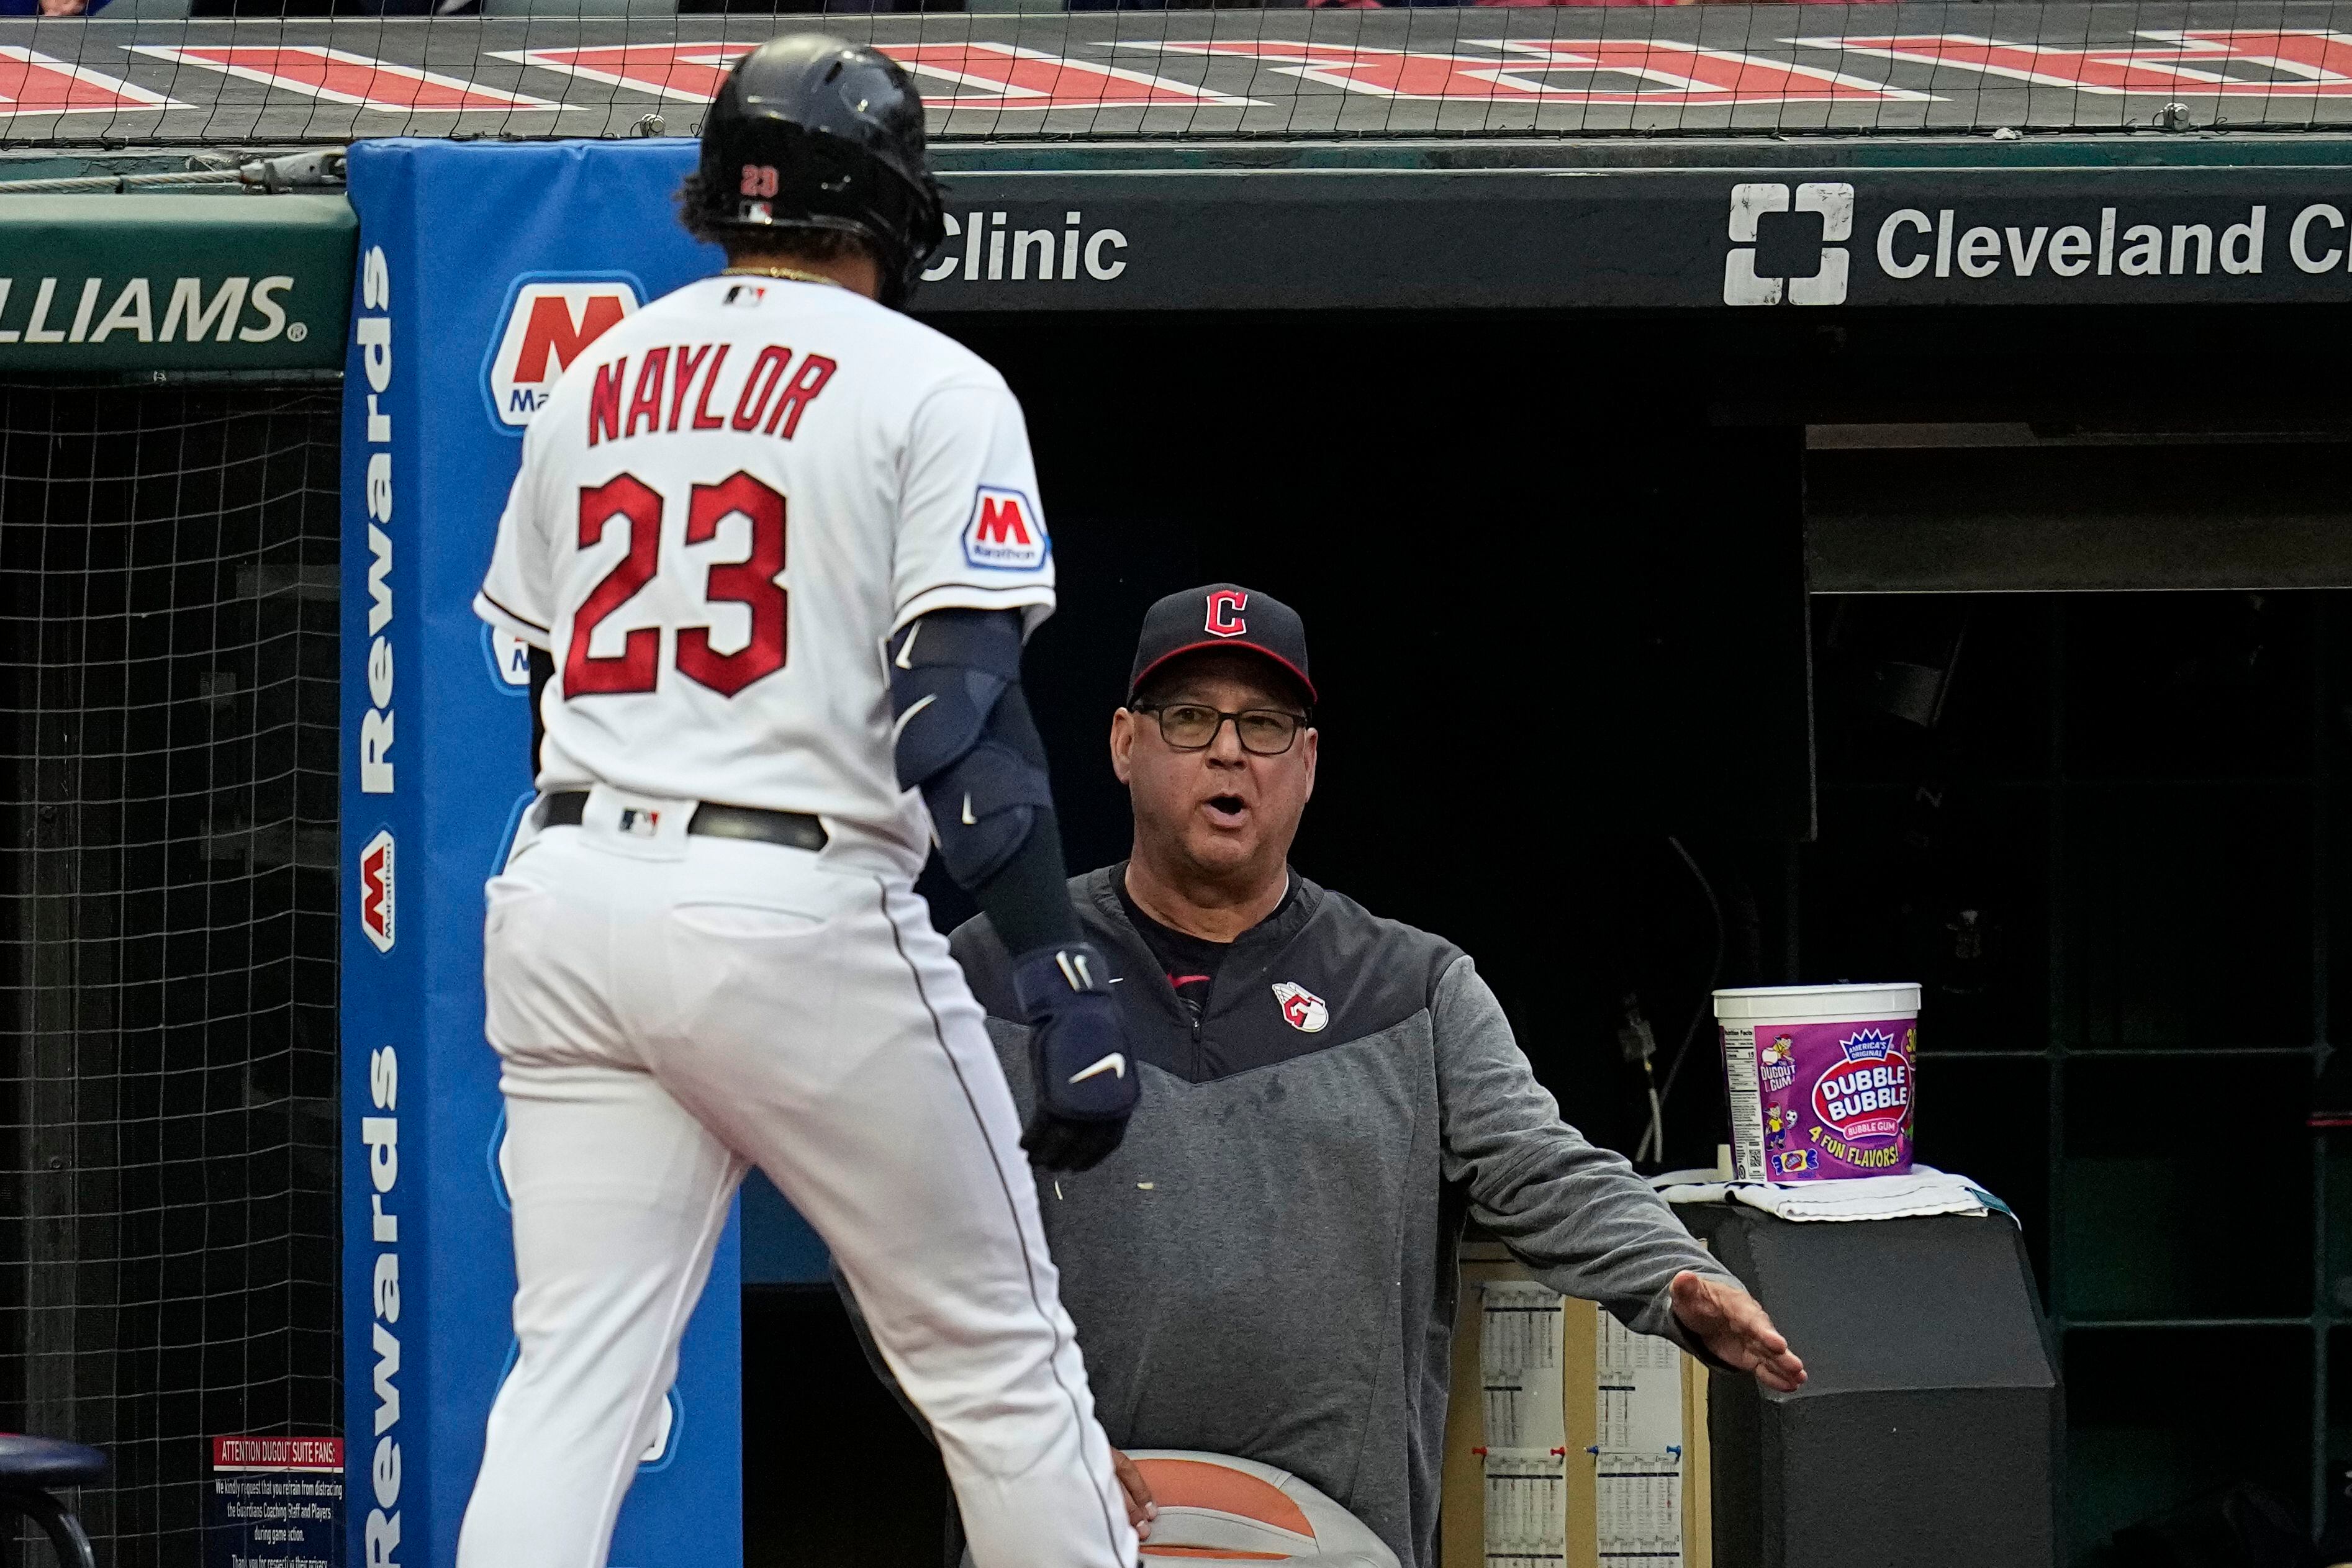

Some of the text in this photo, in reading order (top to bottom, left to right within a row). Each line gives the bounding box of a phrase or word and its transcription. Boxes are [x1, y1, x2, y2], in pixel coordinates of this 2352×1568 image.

[1876, 205, 2266, 279] Cleveland
[587, 344, 838, 448] NAYLOR
[357, 246, 394, 793] Rewards
[563, 470, 787, 701] 23
[1205, 590, 1248, 638] C
[1848, 1042, 1887, 1054] AMERICA'S
[1852, 1049, 1883, 1059] ORIGINAL
[1760, 1065, 1796, 1081] DUGOUT
[1770, 1076, 1792, 1092] GUM
[1821, 1065, 1905, 1101] DUBBLE
[1828, 1086, 1907, 1121] BUBBLE
[1848, 1122, 1896, 1136] BUBBLE GUM
[1808, 1126, 1899, 1168] 4 FUN FLAVORS!
[363, 1045, 402, 1568] Rewards
[222, 1441, 335, 1463] ATTENTION DUGOUT SUITE FANS:
[215, 1479, 224, 1494] We
[225, 1479, 240, 1498] kindly
[261, 1479, 271, 1495] that
[273, 1483, 282, 1498] you
[283, 1480, 301, 1495] refrain
[302, 1480, 314, 1495] from
[227, 1502, 236, 1517] the
[237, 1502, 263, 1518] Guardians
[263, 1502, 286, 1522] Coaching
[301, 1503, 310, 1518] and
[312, 1503, 331, 1522] Players
[254, 1525, 271, 1544] during
[272, 1530, 286, 1544] game
